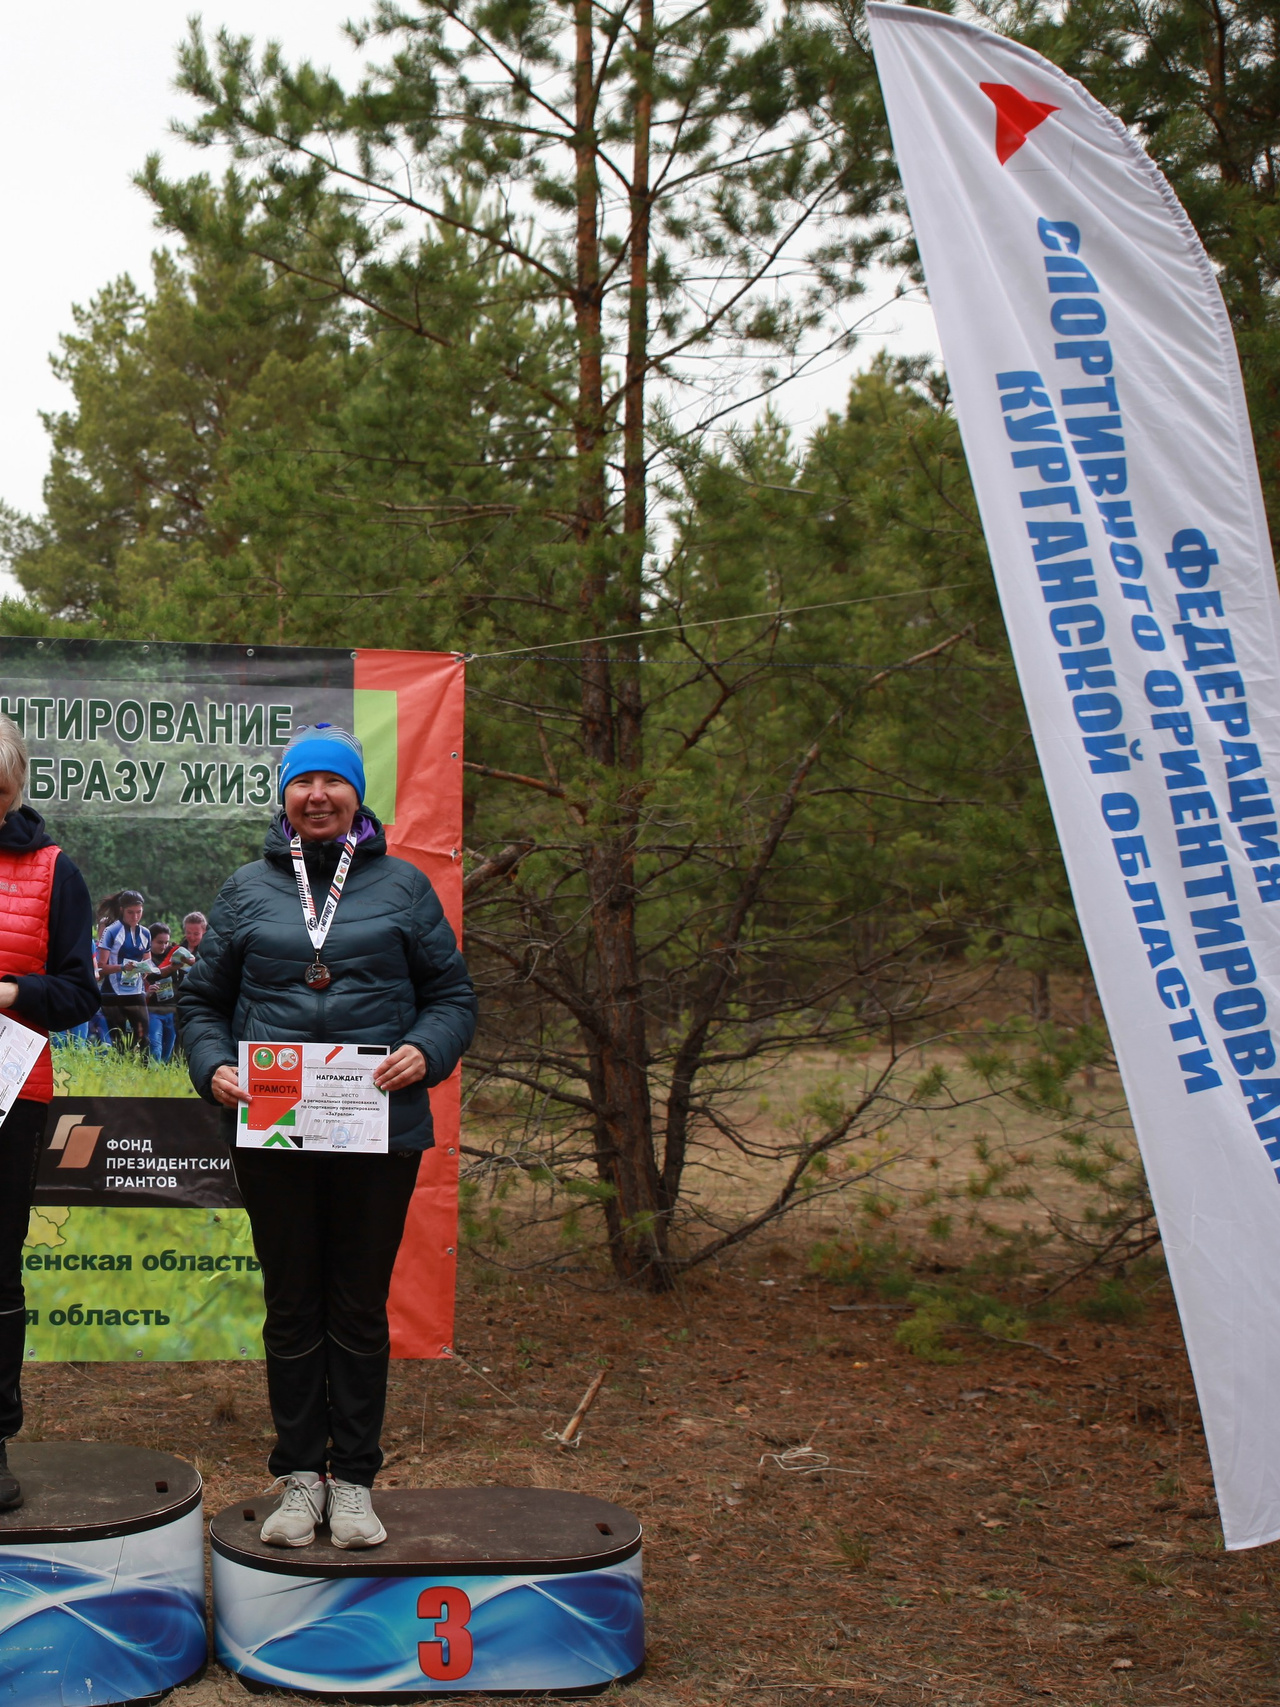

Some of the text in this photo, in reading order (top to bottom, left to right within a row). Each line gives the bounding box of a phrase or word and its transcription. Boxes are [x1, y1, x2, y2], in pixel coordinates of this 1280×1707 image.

[1037, 217, 1280, 1184] СПОРТИВНОГО ОРИЕНТИРОВАН
[1164, 528, 1280, 903] ФЕДЕРАЦИЯ
[996, 370, 1223, 1094] КУРГАНСКОЙ ОБЛАСТИ
[28, 757, 166, 803] БРАЗУ
[180, 762, 283, 806] ЖИЗ
[253, 1084, 298, 1094] ГРАМОТА
[316, 1074, 363, 1082] НАГРАЖДАЕТ
[106, 1139, 153, 1153] ФОНД
[106, 1157, 231, 1171] ПРЕЗИДЕНТСКИ
[106, 1176, 178, 1188] ГРАНТОВ
[142, 1249, 261, 1272] область
[48, 1303, 171, 1328] область
[417, 1586, 473, 1681] 3
